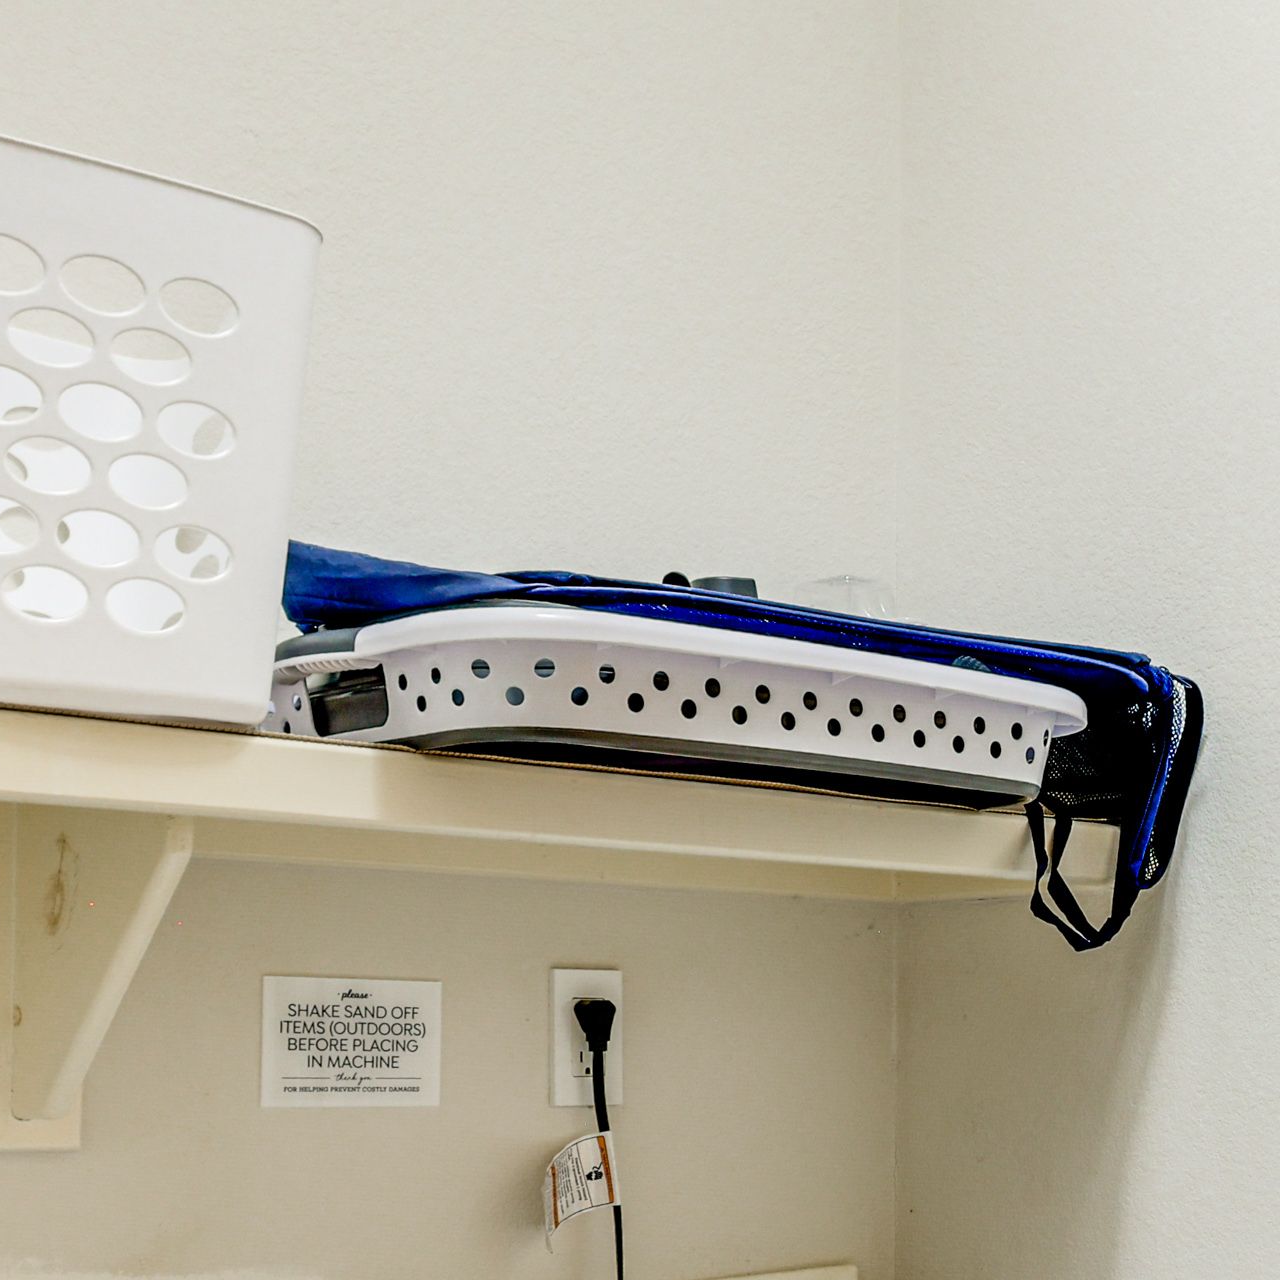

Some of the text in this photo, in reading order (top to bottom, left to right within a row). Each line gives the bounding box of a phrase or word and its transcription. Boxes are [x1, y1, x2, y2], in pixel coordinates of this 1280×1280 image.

[341, 989, 369, 1001] please
[287, 1003, 420, 1020] SHAKE SAND OFF
[279, 1020, 426, 1038] ITEMS (OUTDOORS)
[287, 1038, 419, 1052] BEFORE PLACING
[307, 1055, 400, 1069] IN MACHINE
